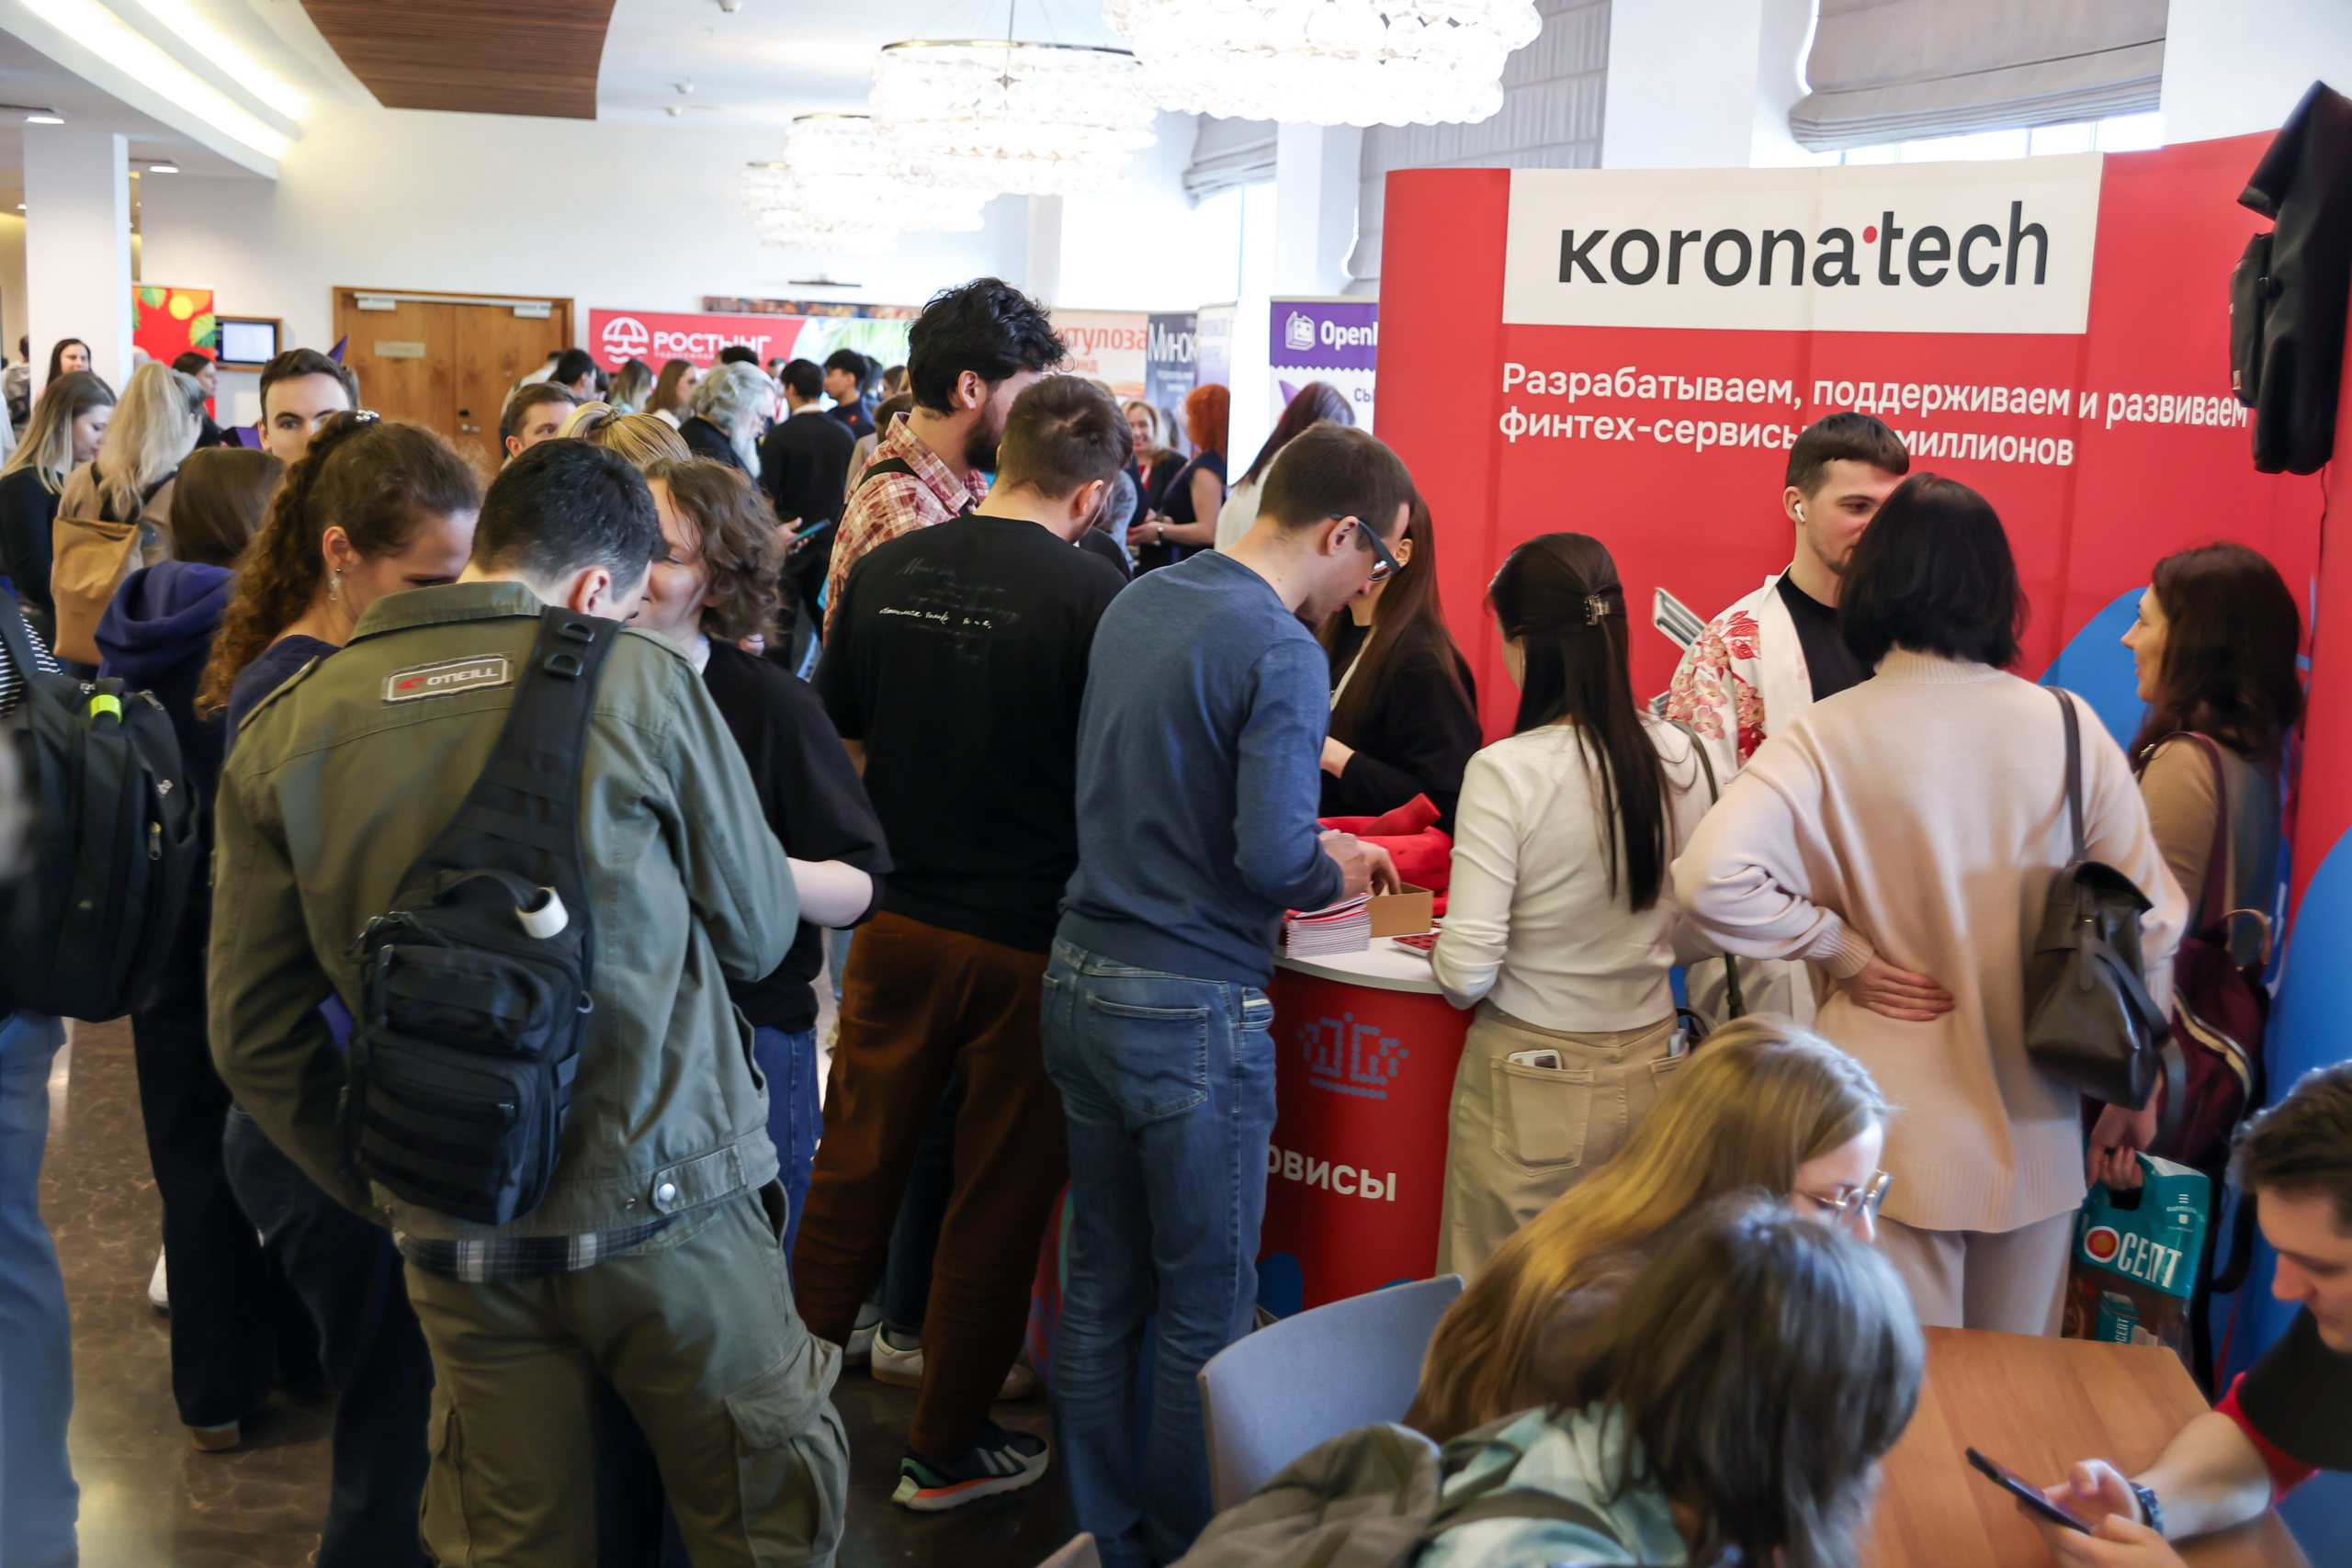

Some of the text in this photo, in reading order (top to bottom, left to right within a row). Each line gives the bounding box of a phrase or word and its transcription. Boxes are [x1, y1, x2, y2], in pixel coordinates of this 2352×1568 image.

[1502, 363, 2248, 429] Разрабатываем, поддерживаем и развиваем
[1894, 429, 2074, 466] миллионов
